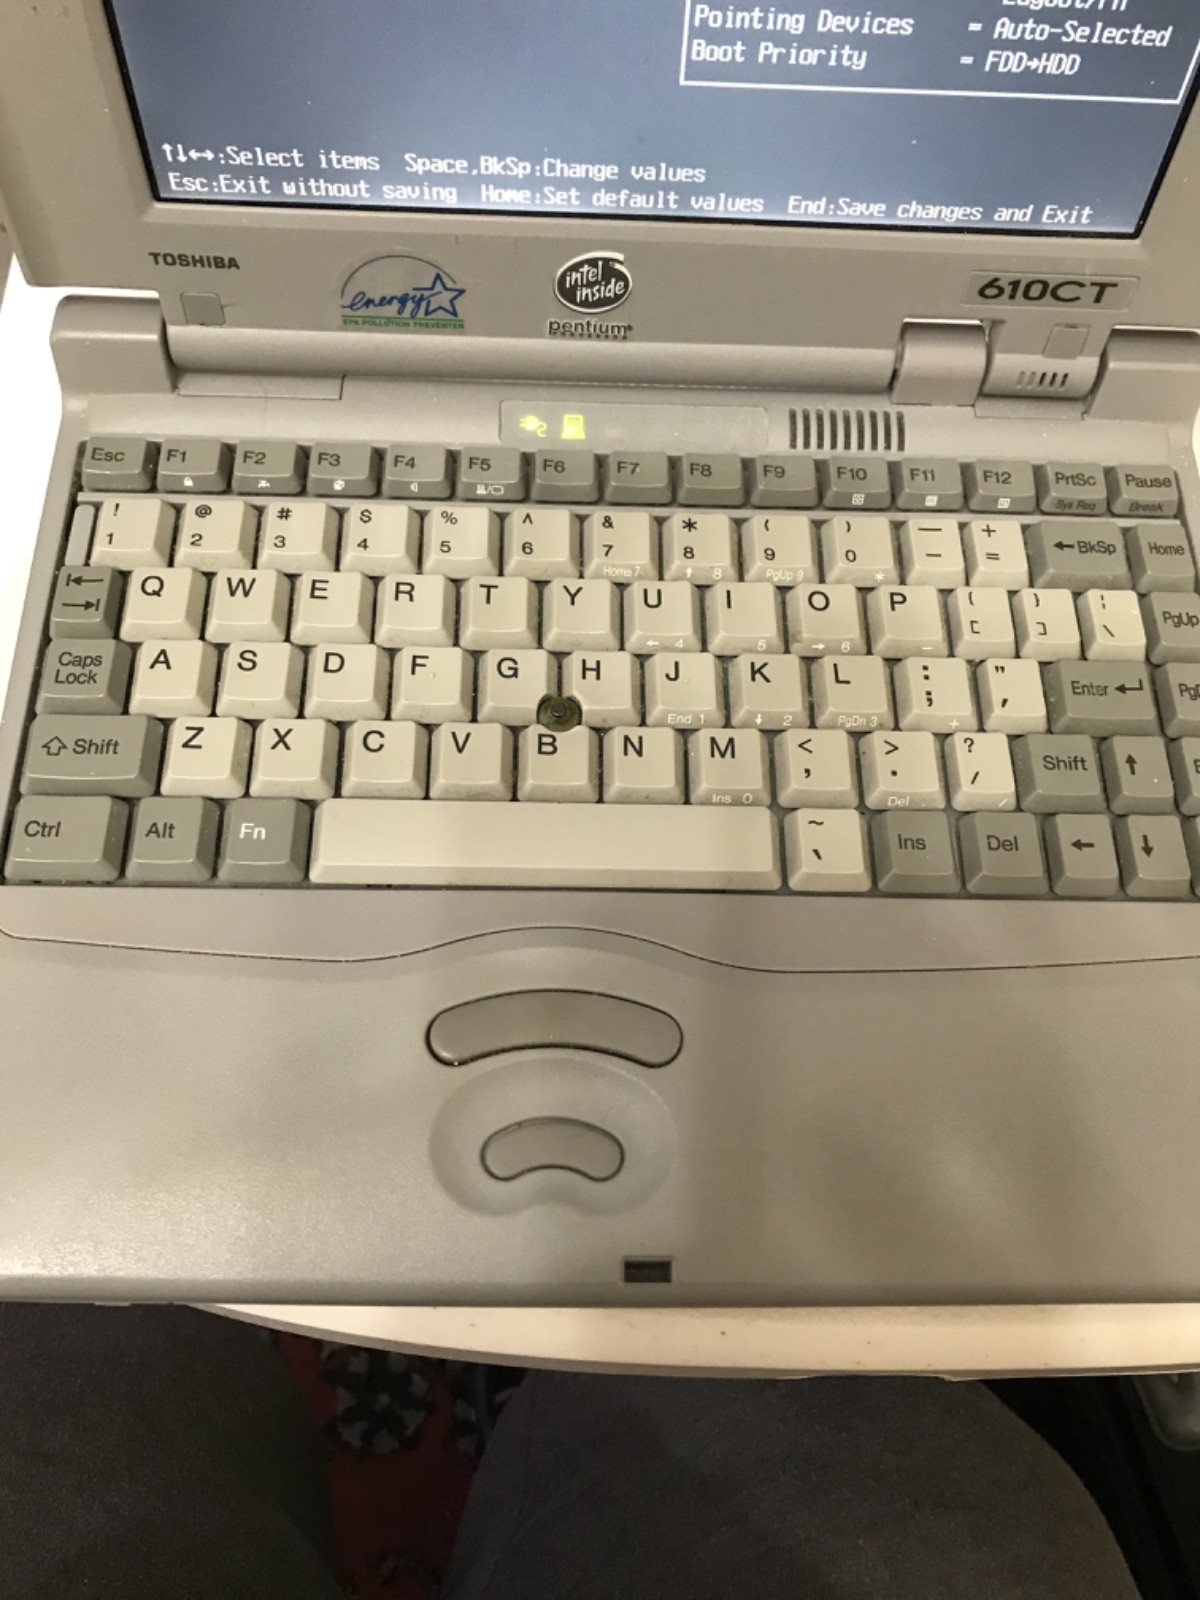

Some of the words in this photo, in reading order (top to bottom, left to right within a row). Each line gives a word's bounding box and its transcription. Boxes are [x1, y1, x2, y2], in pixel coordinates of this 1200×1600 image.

[694, 4, 805, 34] Pointing
[816, 9, 914, 35] Devices
[993, 17, 1173, 47] Auto-Selected
[691, 39, 746, 62] Boot
[758, 41, 867, 70] Priority
[319, 149, 380, 171] items
[631, 162, 706, 183] values
[282, 179, 370, 199] without
[382, 181, 457, 203] saving
[592, 189, 679, 209] default
[690, 193, 764, 213] values
[897, 200, 983, 221] changes
[993, 204, 1033, 222] and
[1041, 205, 1093, 225] Exit
[148, 252, 240, 270] TOSHIBA
[565, 259, 603, 289] intel
[576, 278, 625, 304] inside
[977, 277, 1118, 304] 610CT
[341, 291, 432, 319] energy
[91, 447, 125, 463] Esc
[166, 449, 187, 463] F1
[242, 451, 267, 465] F2
[317, 453, 341, 467] F3
[393, 455, 416, 469] F4
[468, 457, 492, 471] F5
[542, 459, 566, 473] F6
[616, 461, 640, 475] F7
[690, 463, 712, 477] F8
[763, 465, 786, 478] F9
[837, 466, 868, 481] F10
[909, 468, 935, 482] F11
[983, 470, 1012, 485] F12
[1054, 471, 1097, 487] PrtSc
[1125, 474, 1172, 488] Pause
[113, 502, 120, 517] !
[194, 504, 213, 518] @
[1055, 500, 1074, 511] Sys
[1076, 500, 1096, 511] Req
[1128, 501, 1164, 513] Break
[276, 507, 292, 521] #
[440, 511, 458, 525] %
[602, 515, 614, 529] &
[106, 533, 114, 545] 1
[980, 524, 997, 538] +
[190, 533, 203, 547] 2
[273, 535, 286, 549] 3
[357, 538, 370, 551] 4
[439, 540, 452, 553] 5
[1077, 540, 1117, 556] BkSp
[1147, 540, 1185, 556] Home
[521, 542, 534, 555] 6
[602, 544, 614, 557] 7
[683, 546, 695, 560] 8
[763, 547, 776, 561] 9
[603, 566, 633, 576] Home
[634, 566, 641, 576] 7
[712, 567, 722, 580] 8
[766, 569, 793, 582] PgUp
[796, 569, 804, 581] 9
[140, 575, 165, 598] Q
[226, 577, 256, 598] W
[309, 579, 329, 600] E
[394, 581, 416, 603] R
[479, 583, 499, 605] T
[563, 585, 583, 606] Y
[643, 588, 663, 609] U
[807, 590, 830, 611] O
[889, 591, 907, 612] P
[1162, 610, 1199, 627] PgUp
[674, 638, 684, 649] 4
[757, 639, 767, 651] 5
[840, 641, 851, 652] 6
[57, 651, 103, 668] Caps
[149, 648, 172, 670] A
[236, 650, 258, 672] S
[323, 652, 345, 674] D
[410, 655, 430, 675] F
[496, 657, 519, 679] G
[581, 658, 601, 681] H
[665, 660, 680, 682] J
[750, 661, 772, 683] K
[832, 662, 851, 685] L
[54, 669, 98, 685] Lock
[1070, 680, 1109, 697] Enter
[667, 713, 691, 725] End
[783, 715, 793, 726] 2
[838, 716, 866, 728] PgDn
[869, 716, 879, 727] 3
[181, 726, 205, 749] Z
[270, 728, 293, 751] X
[362, 730, 385, 753] C
[451, 731, 472, 754] V
[537, 733, 558, 755] B
[963, 737, 975, 753] ?
[72, 738, 120, 755] Shift
[623, 734, 644, 758] N
[709, 736, 736, 759] M
[797, 738, 813, 754] <
[883, 740, 899, 756] >
[1042, 755, 1088, 772] Shift
[970, 771, 980, 785] /
[712, 793, 731, 804] Ins
[887, 796, 910, 807] Del
[24, 820, 61, 838] Ctrl
[145, 822, 175, 839] Alt
[239, 823, 266, 840] Fn
[897, 833, 927, 850] Ins
[986, 834, 1019, 851] Del
